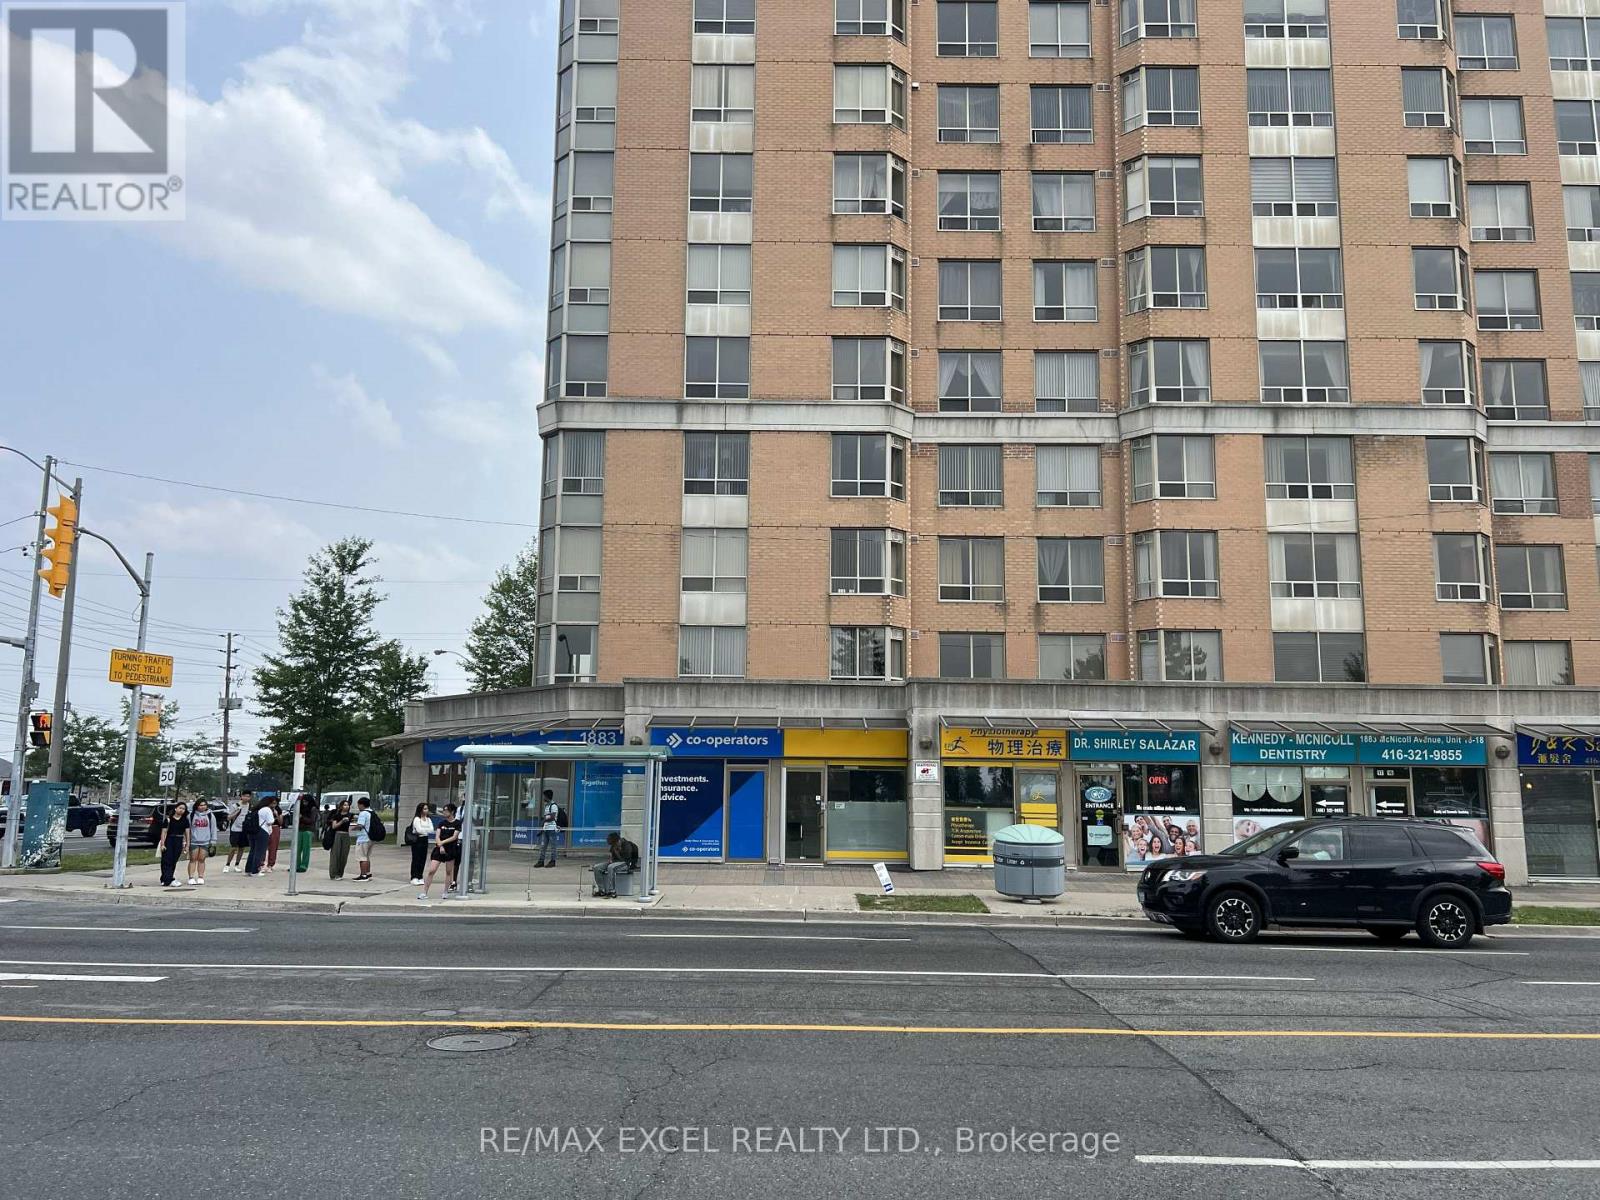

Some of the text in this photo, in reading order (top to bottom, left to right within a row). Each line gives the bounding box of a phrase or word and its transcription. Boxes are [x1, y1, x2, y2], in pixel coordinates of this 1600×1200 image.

[114, 652, 172, 666] TURNING TRAFFIC
[114, 671, 169, 684] TO PEDESTRIANS
[580, 731, 616, 745] 1883
[686, 735, 769, 748] co-operators
[1232, 733, 1286, 744] KENNEDY
[1296, 734, 1354, 745] MCNICOLL
[987, 739, 1063, 756] 物理治療
[1074, 738, 1196, 751] DR. SHIRLEY SALAZAR
[1260, 749, 1327, 760] DENTISTRY
[1381, 749, 1463, 761] 416-321-9855
[161, 771, 174, 781] 50
[659, 775, 709, 783] nvestments.
[1148, 776, 1168, 784] OPEN
[659, 793, 687, 801] dvice.
